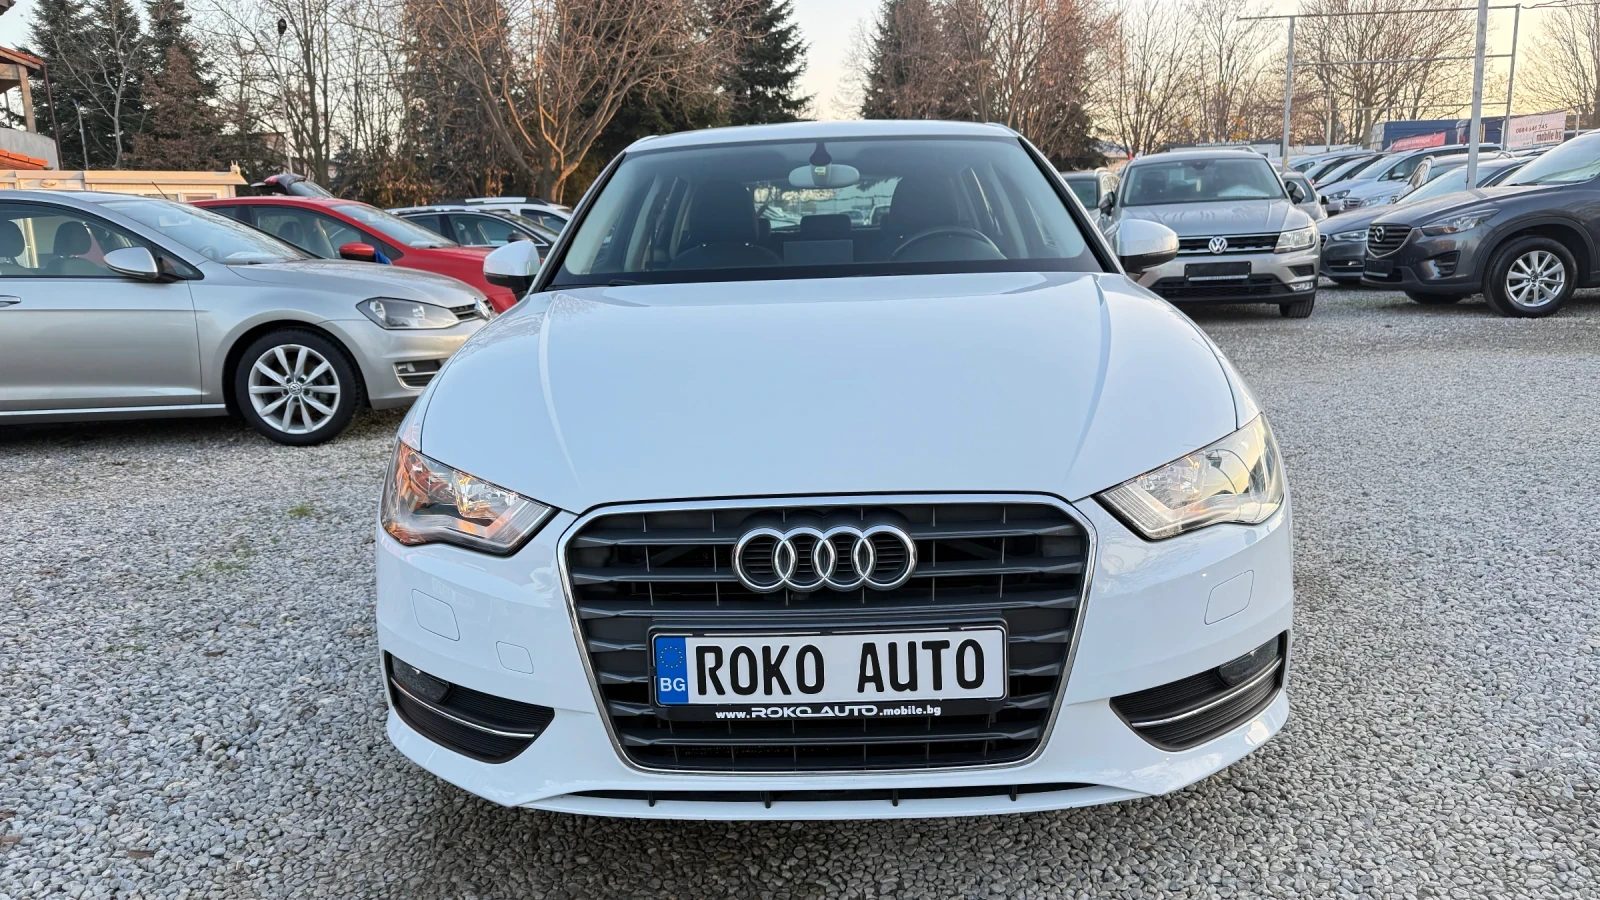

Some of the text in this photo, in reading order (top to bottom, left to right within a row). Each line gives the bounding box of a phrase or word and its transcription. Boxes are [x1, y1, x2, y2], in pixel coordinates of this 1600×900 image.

[660, 677, 686, 692] BG
[696, 638, 985, 696] ROKO AUTO
